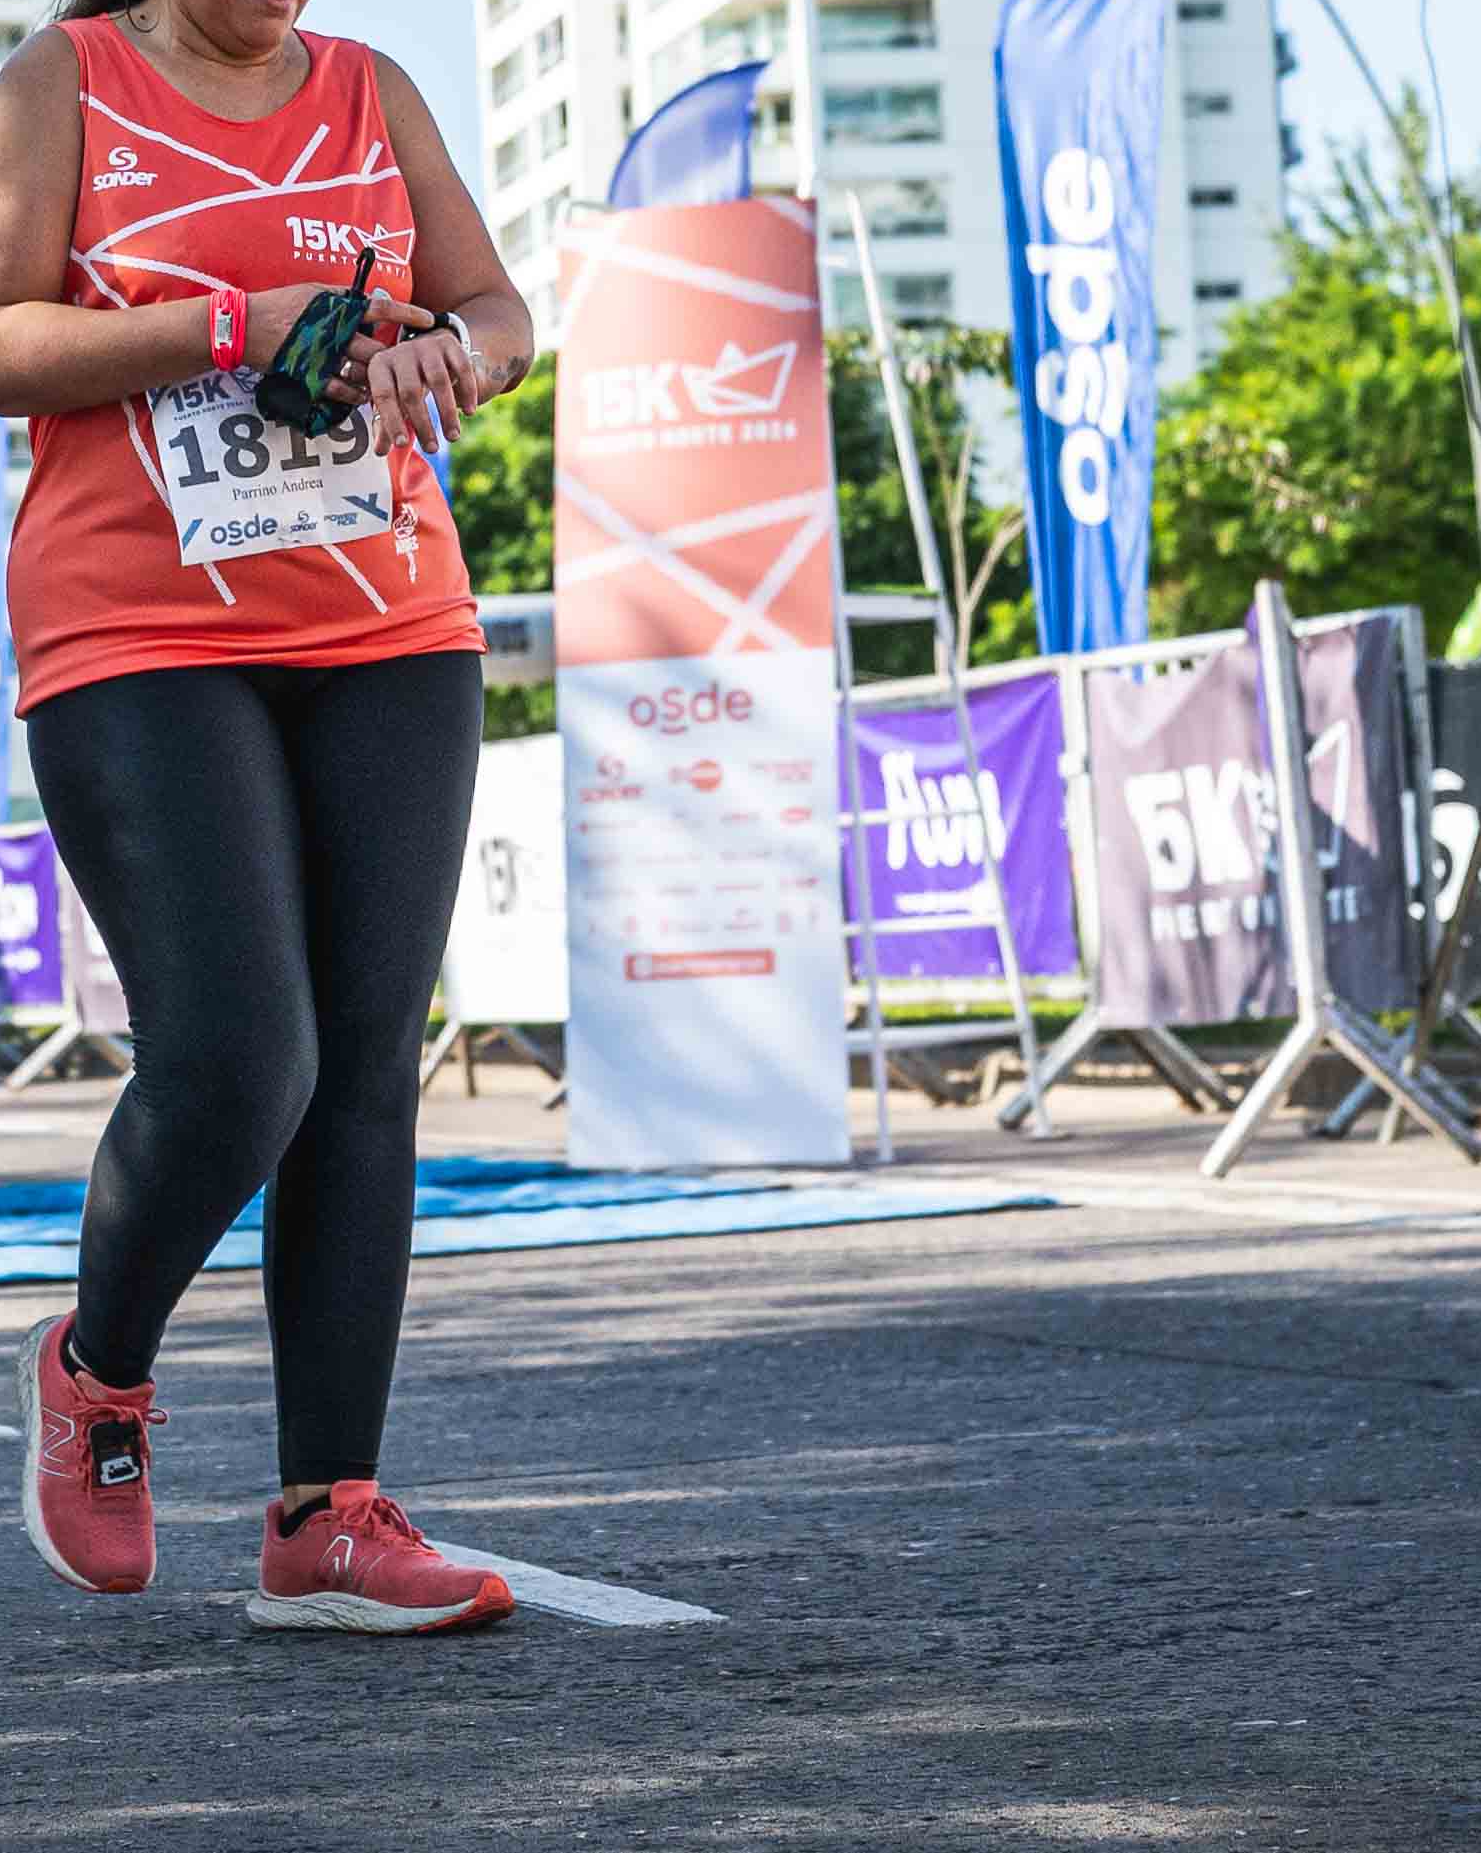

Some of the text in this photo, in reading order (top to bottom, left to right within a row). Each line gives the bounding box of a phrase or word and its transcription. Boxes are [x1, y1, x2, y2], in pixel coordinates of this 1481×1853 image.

[285, 216, 358, 255] 15K
[1026, 147, 1129, 527] osde
[167, 373, 231, 414] 15K
[582, 359, 681, 430] 15K
[168, 405, 370, 488] 1819
[231, 477, 324, 502] Parrino Andrea
[210, 513, 278, 546] osde
[628, 680, 754, 736] osde
